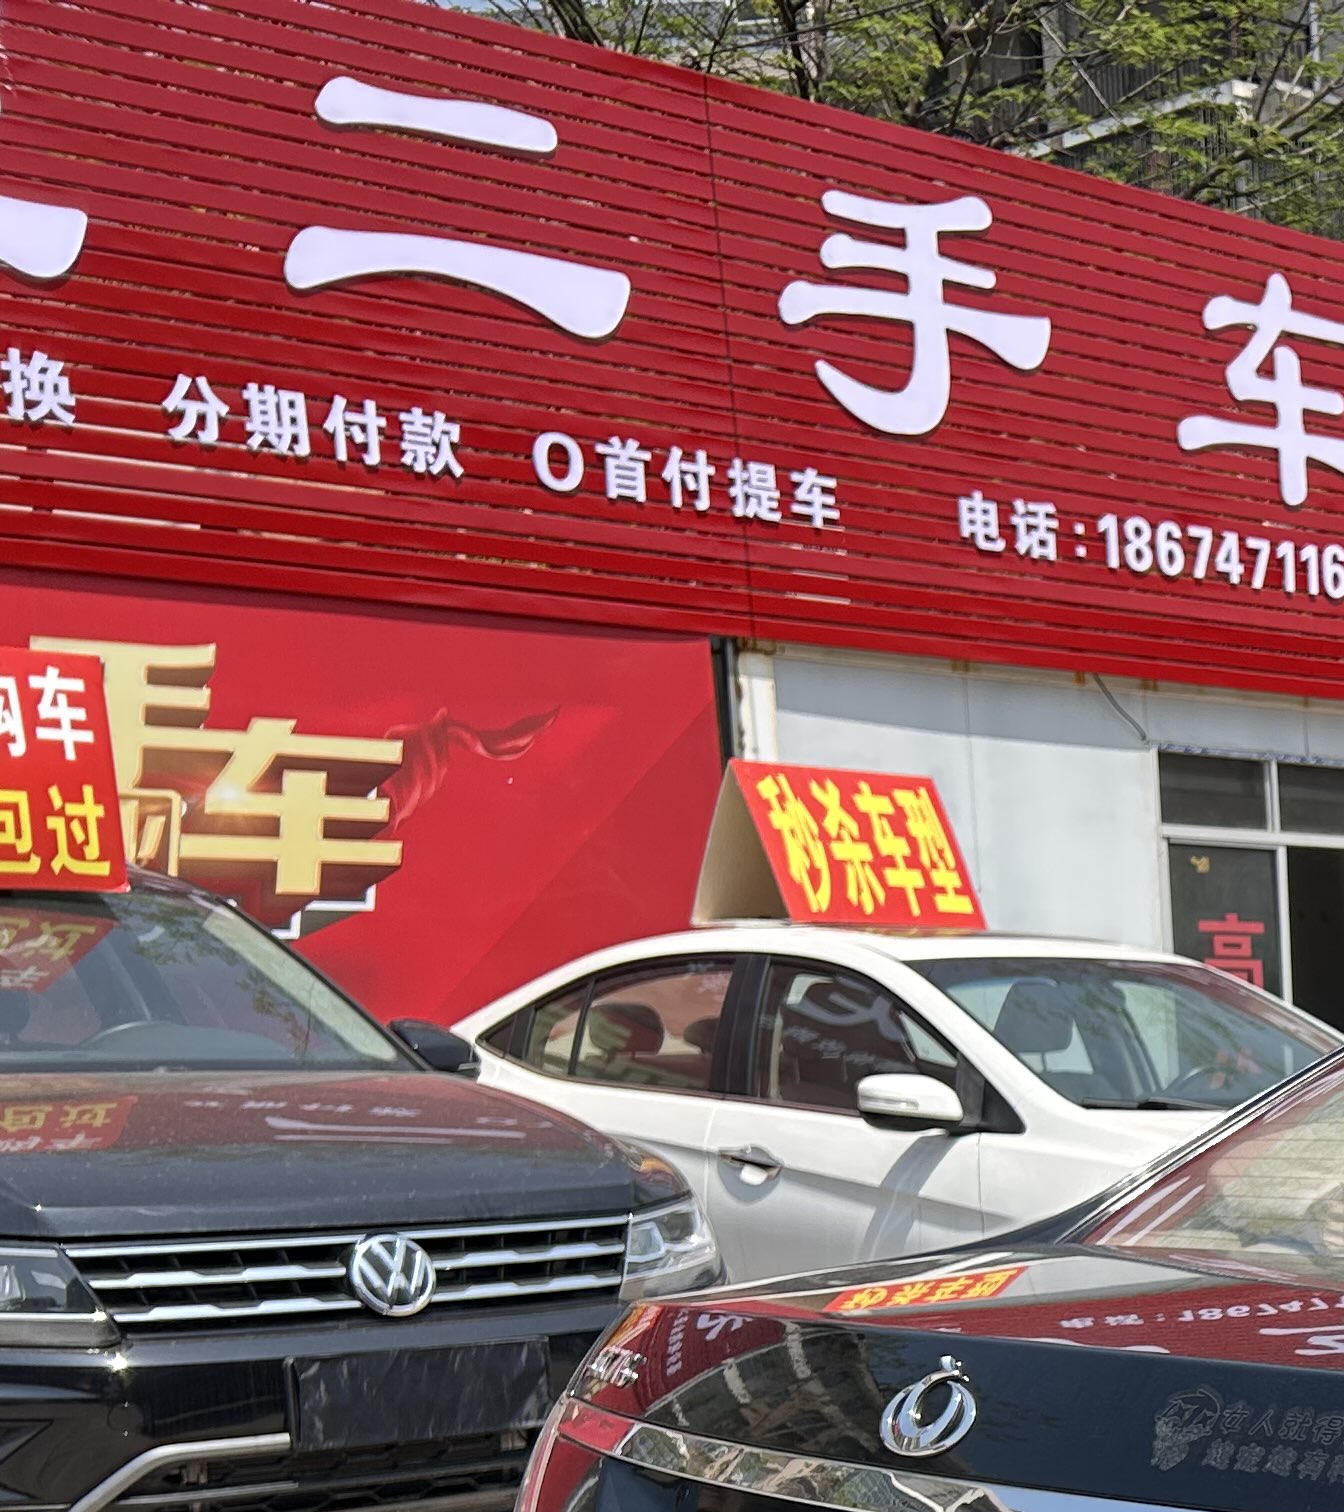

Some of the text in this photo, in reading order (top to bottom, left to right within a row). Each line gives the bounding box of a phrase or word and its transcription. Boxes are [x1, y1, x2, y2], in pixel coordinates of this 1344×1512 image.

[0, 347, 76, 425] 换
[161, 373, 465, 477] 分期付款
[757, 774, 975, 917] 秒杀车型
[1197, 912, 1266, 990] 高
